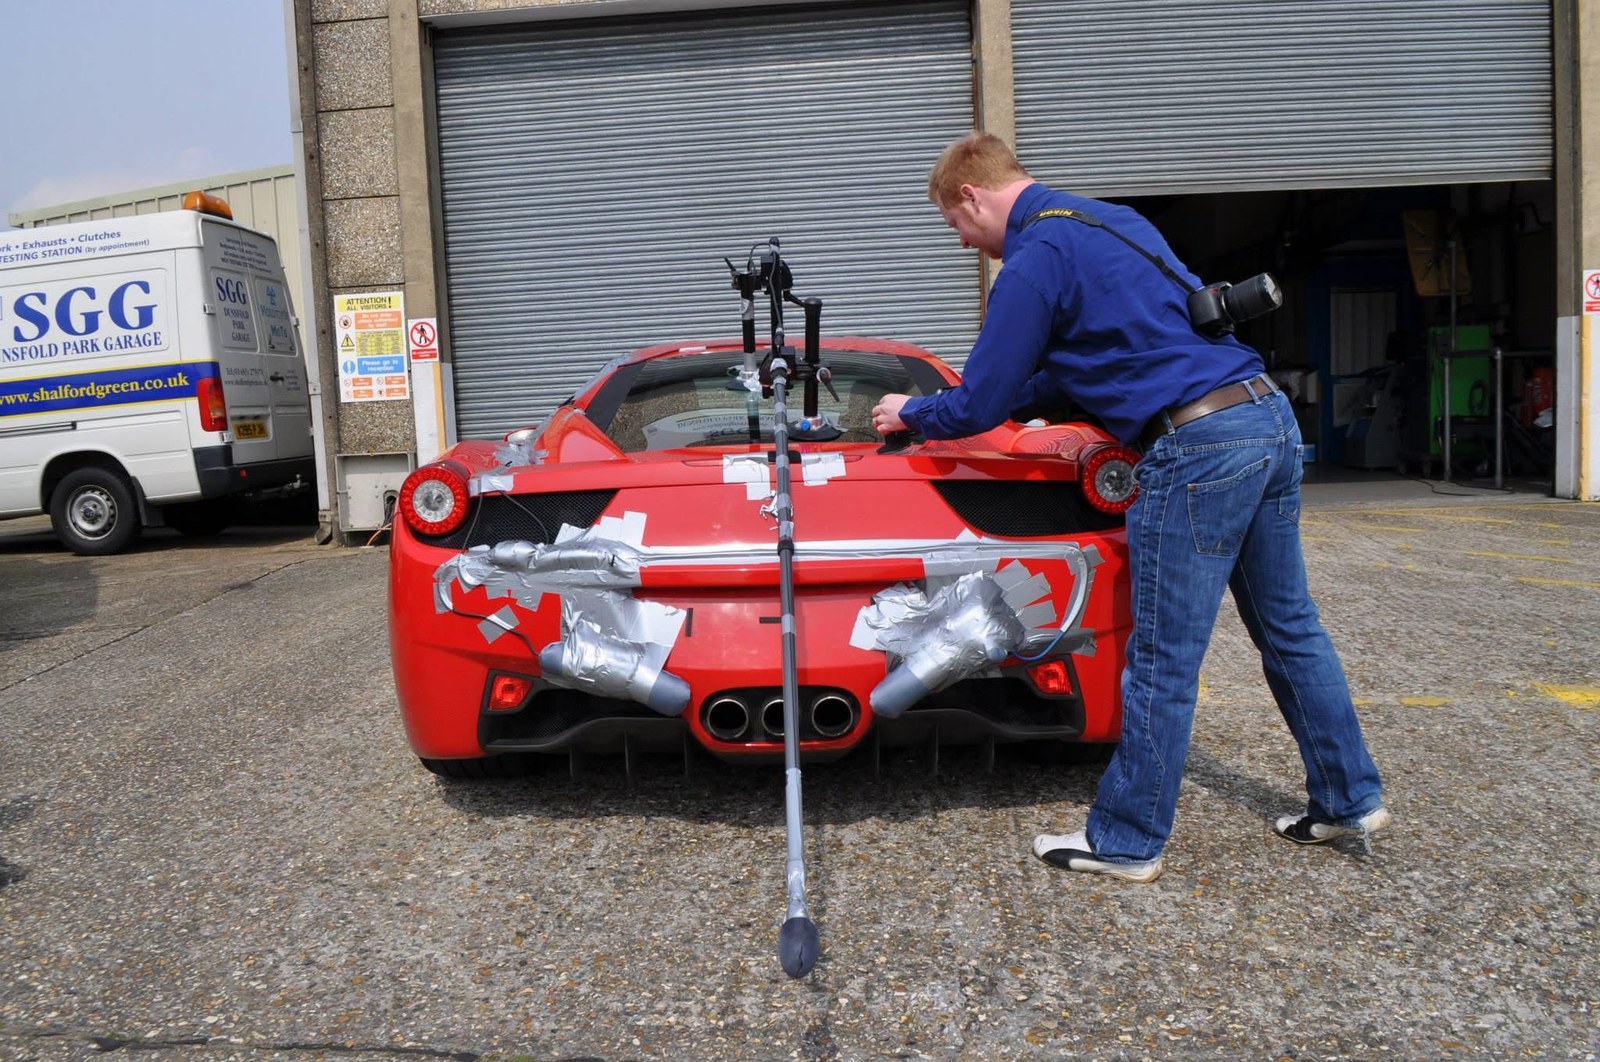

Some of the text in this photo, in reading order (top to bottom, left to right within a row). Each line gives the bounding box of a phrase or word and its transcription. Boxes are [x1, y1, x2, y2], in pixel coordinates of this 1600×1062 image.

[0, 231, 122, 252] rk Exhausts Clutches
[41, 246, 83, 259] STATION
[85, 246, 97, 254] (by
[99, 239, 150, 252] appointment)
[216, 276, 246, 305] SGG
[346, 296, 387, 305] ATTENTION
[13, 280, 158, 343] SGG
[2, 331, 162, 363] NSFOLD PARK GARAGE
